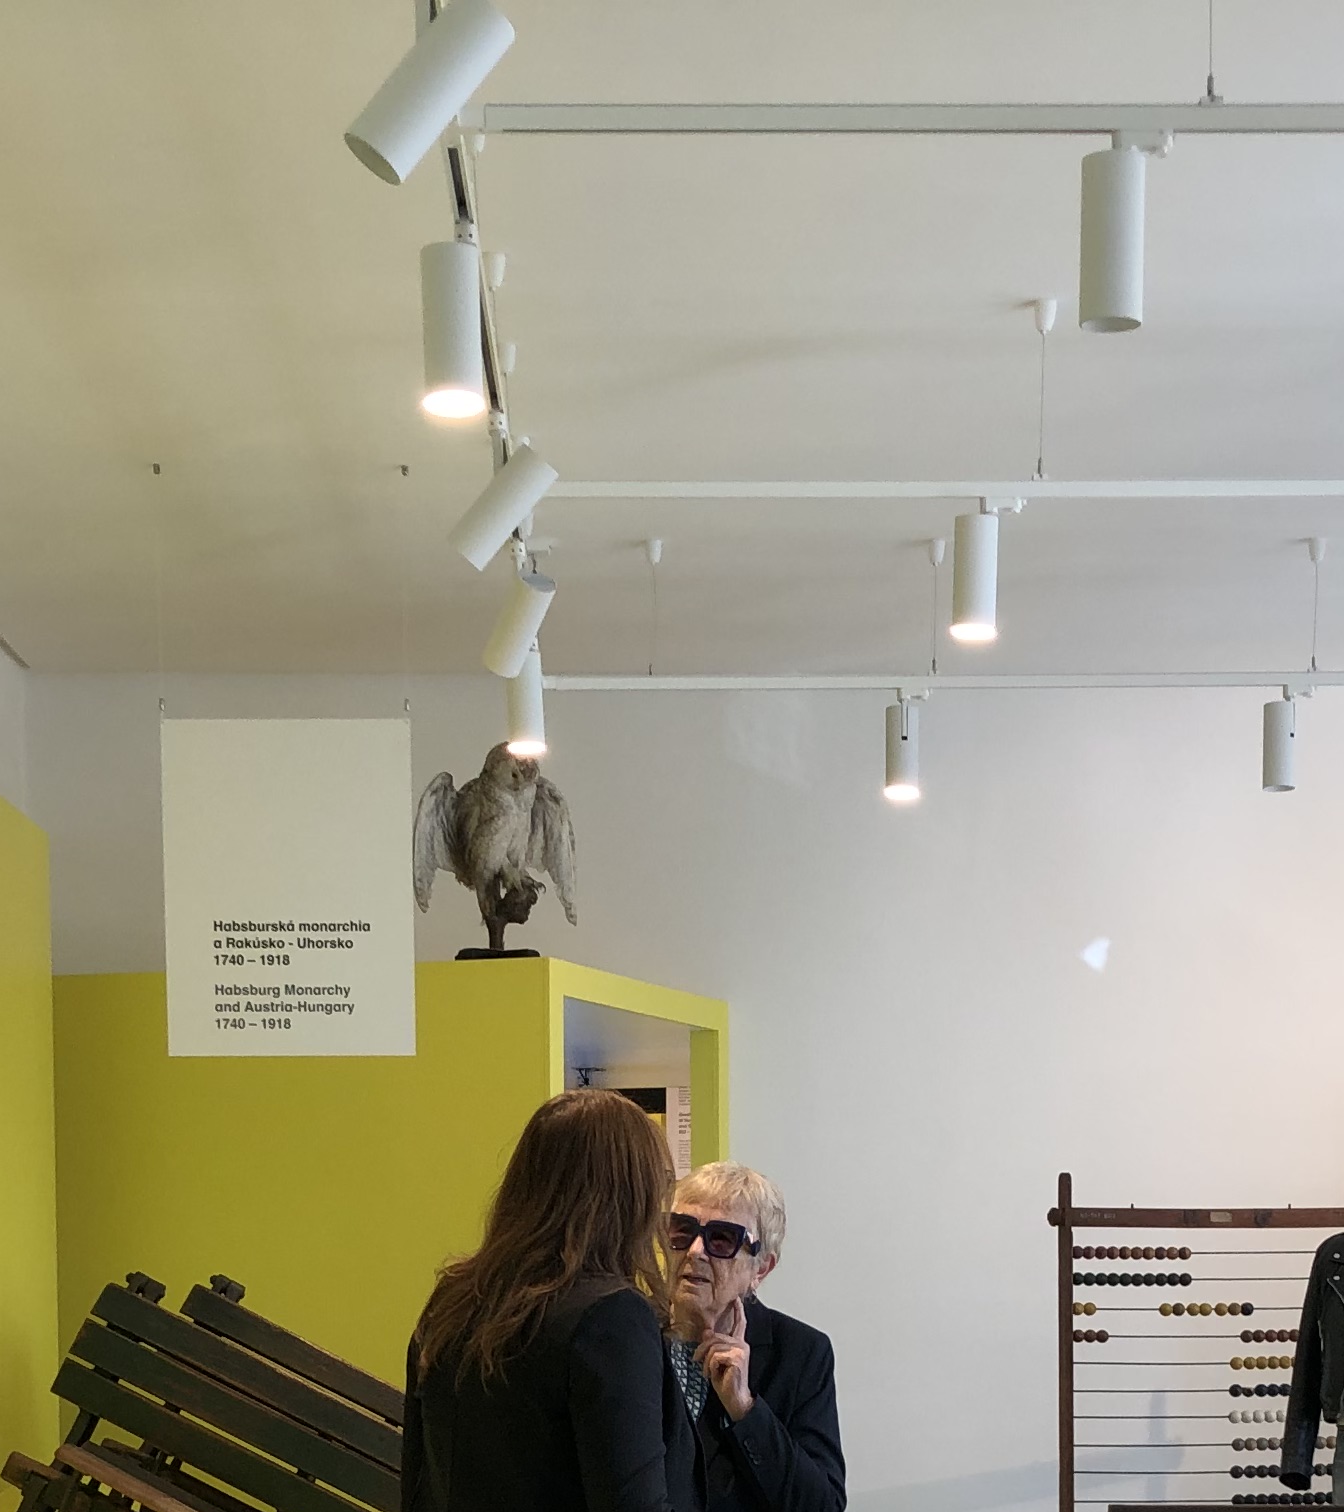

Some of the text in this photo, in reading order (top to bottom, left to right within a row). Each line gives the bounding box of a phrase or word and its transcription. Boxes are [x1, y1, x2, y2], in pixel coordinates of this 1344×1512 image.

[213, 919, 370, 932] Habsburská monarchia
[213, 939, 222, 948] a
[226, 936, 285, 948] Rakúsko
[296, 937, 353, 948] Uhorsko
[213, 954, 244, 966] 1740
[259, 954, 290, 966] 1918
[214, 983, 350, 998] Habsburg Monarchy
[214, 1000, 354, 1015] and Austria-Hungary
[215, 1017, 245, 1029] 1740
[260, 1017, 291, 1029] 1918
